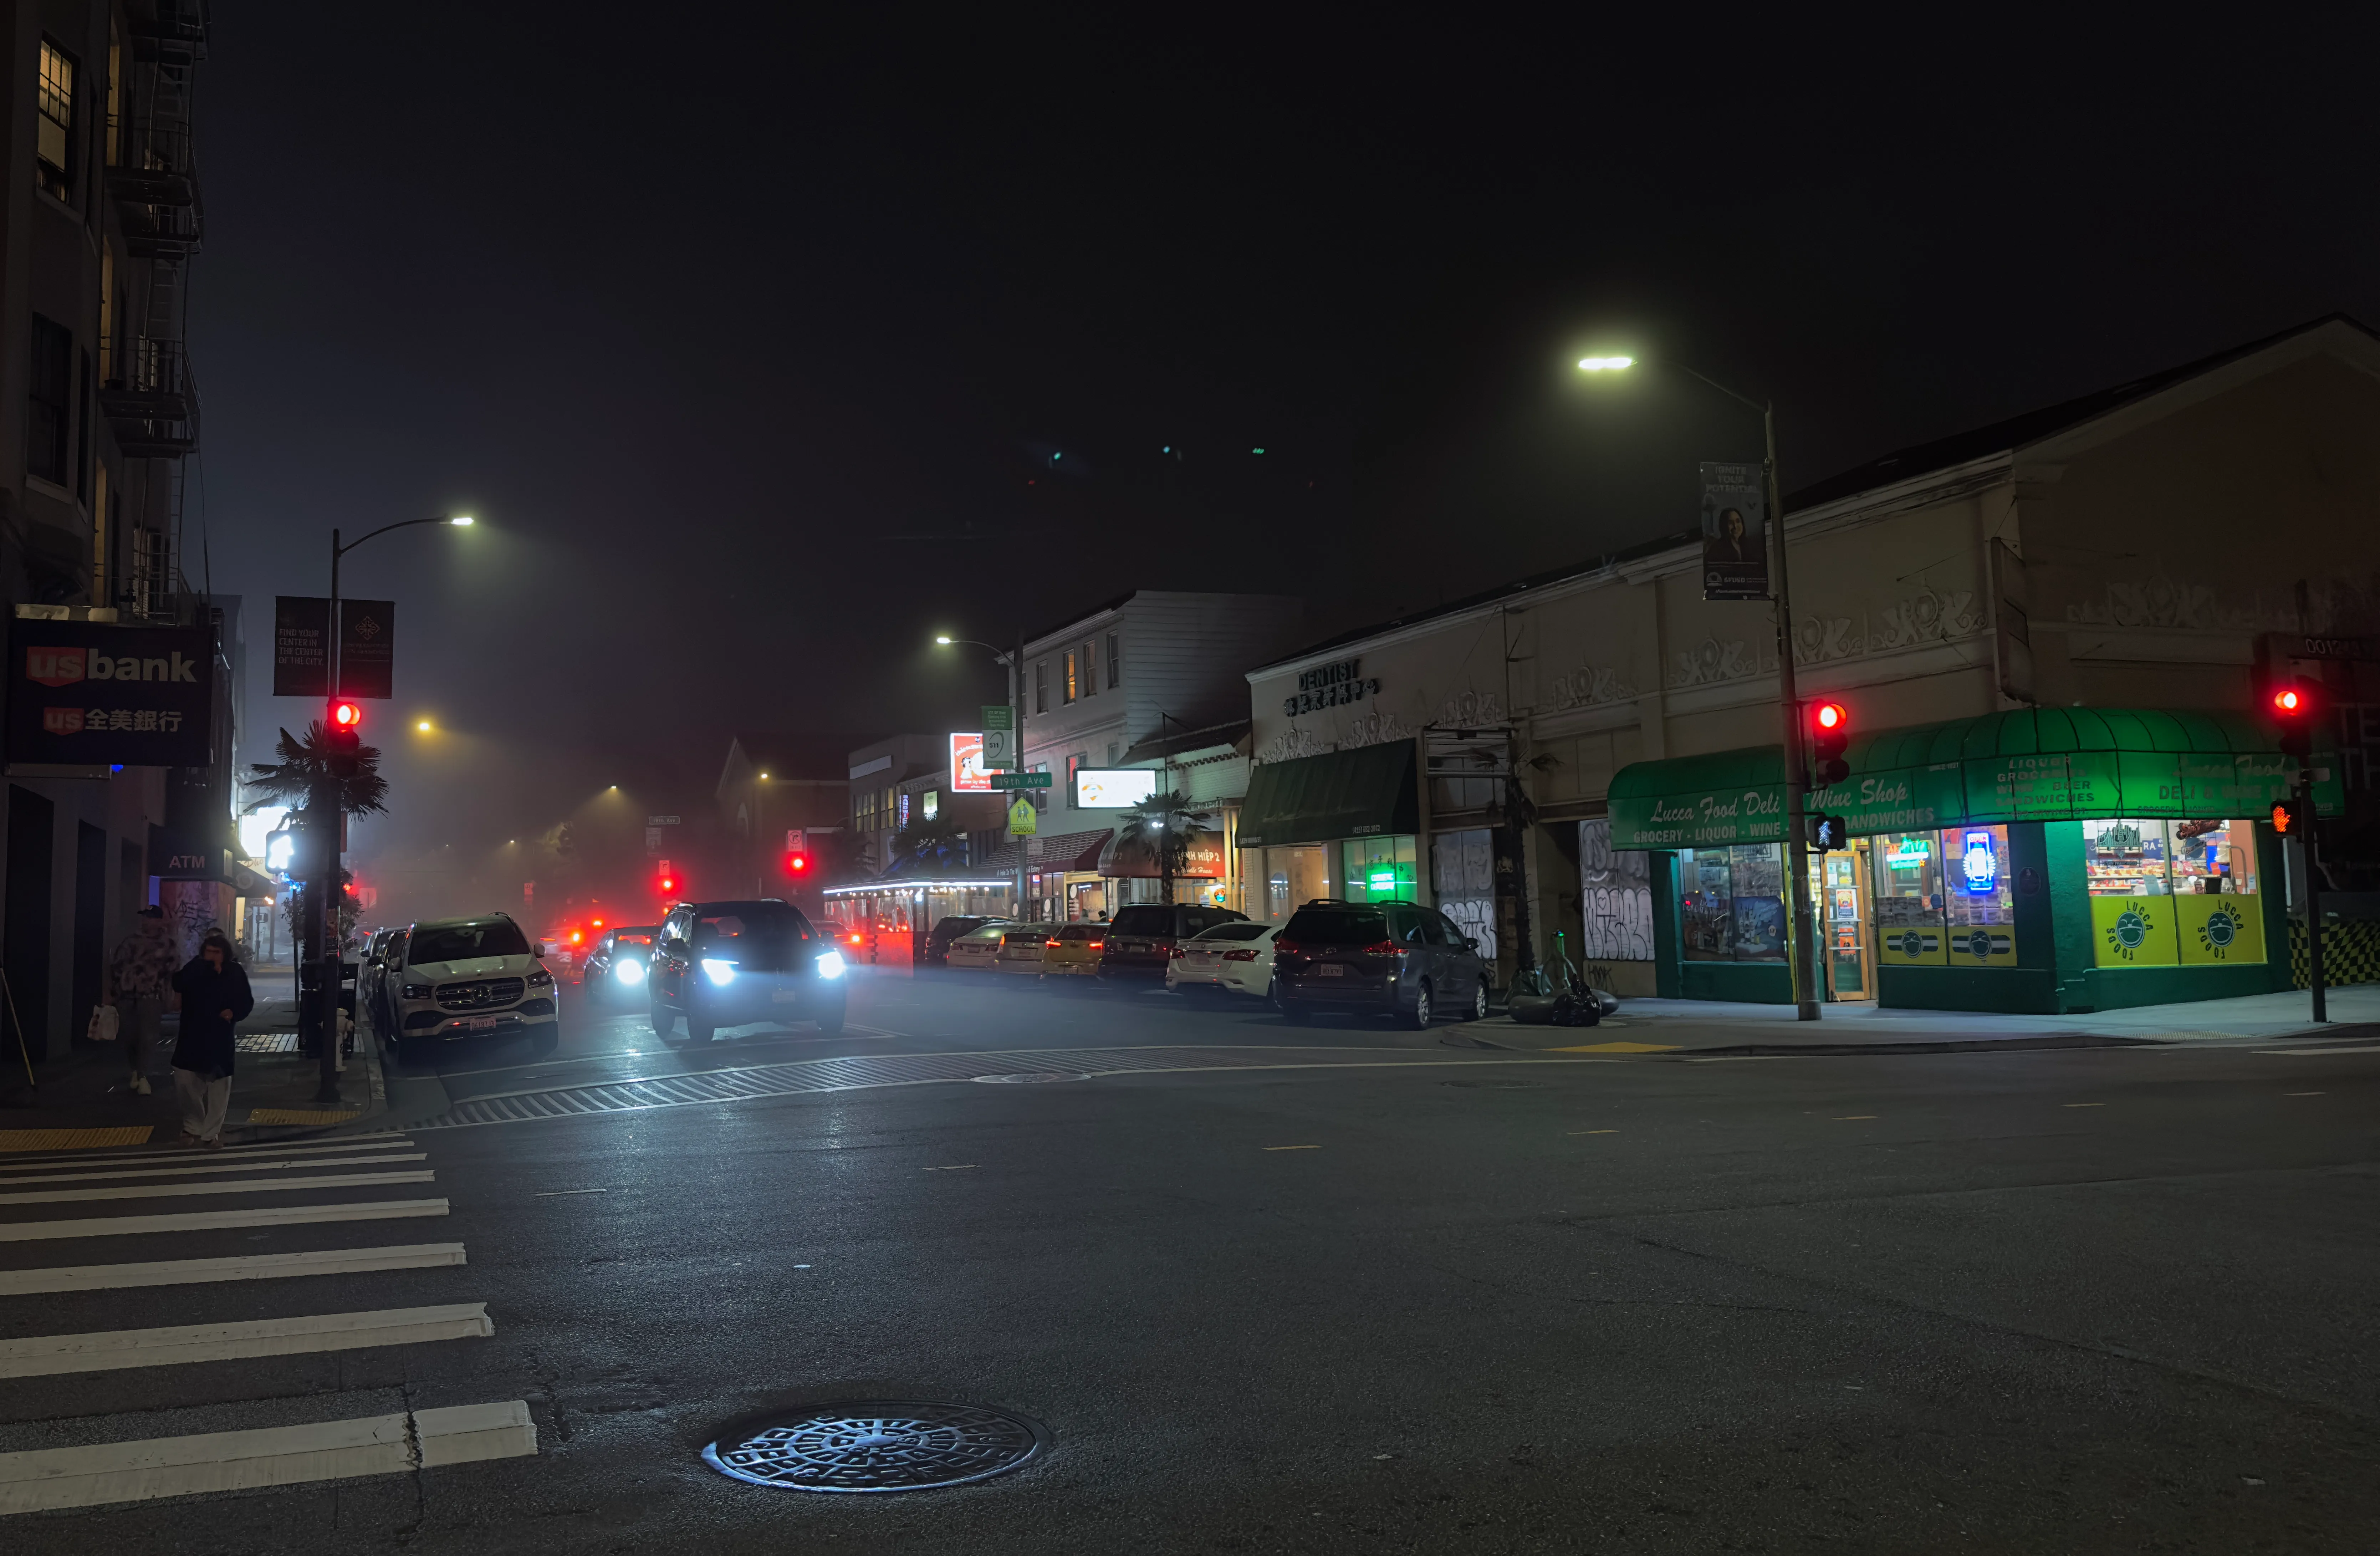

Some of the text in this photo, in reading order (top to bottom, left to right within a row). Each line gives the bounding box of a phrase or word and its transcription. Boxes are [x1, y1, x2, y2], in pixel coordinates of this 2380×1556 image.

[279, 628, 319, 637] FIND YOUR
[279, 638, 307, 646] CENTER
[295, 648, 323, 656] CENTER
[1299, 660, 1359, 691] DENTIST
[85, 708, 182, 732] 全美銀行
[1810, 779, 1908, 809] Wine Shop
[1996, 793, 2094, 806] SANDWICHES
[2159, 785, 2195, 799] DELI
[1650, 791, 1781, 823] Lucca Food Deli
[1845, 807, 1933, 830] SANDWICHES
[1634, 822, 1781, 843] GROCERY LIQUOR WINE
[169, 856, 205, 868] ATM
[1198, 849, 1214, 863] HIỆP
[1215, 852, 1220, 861] 2
[2126, 901, 2154, 930] LUCCA
[2218, 899, 2244, 930] LUCCA
